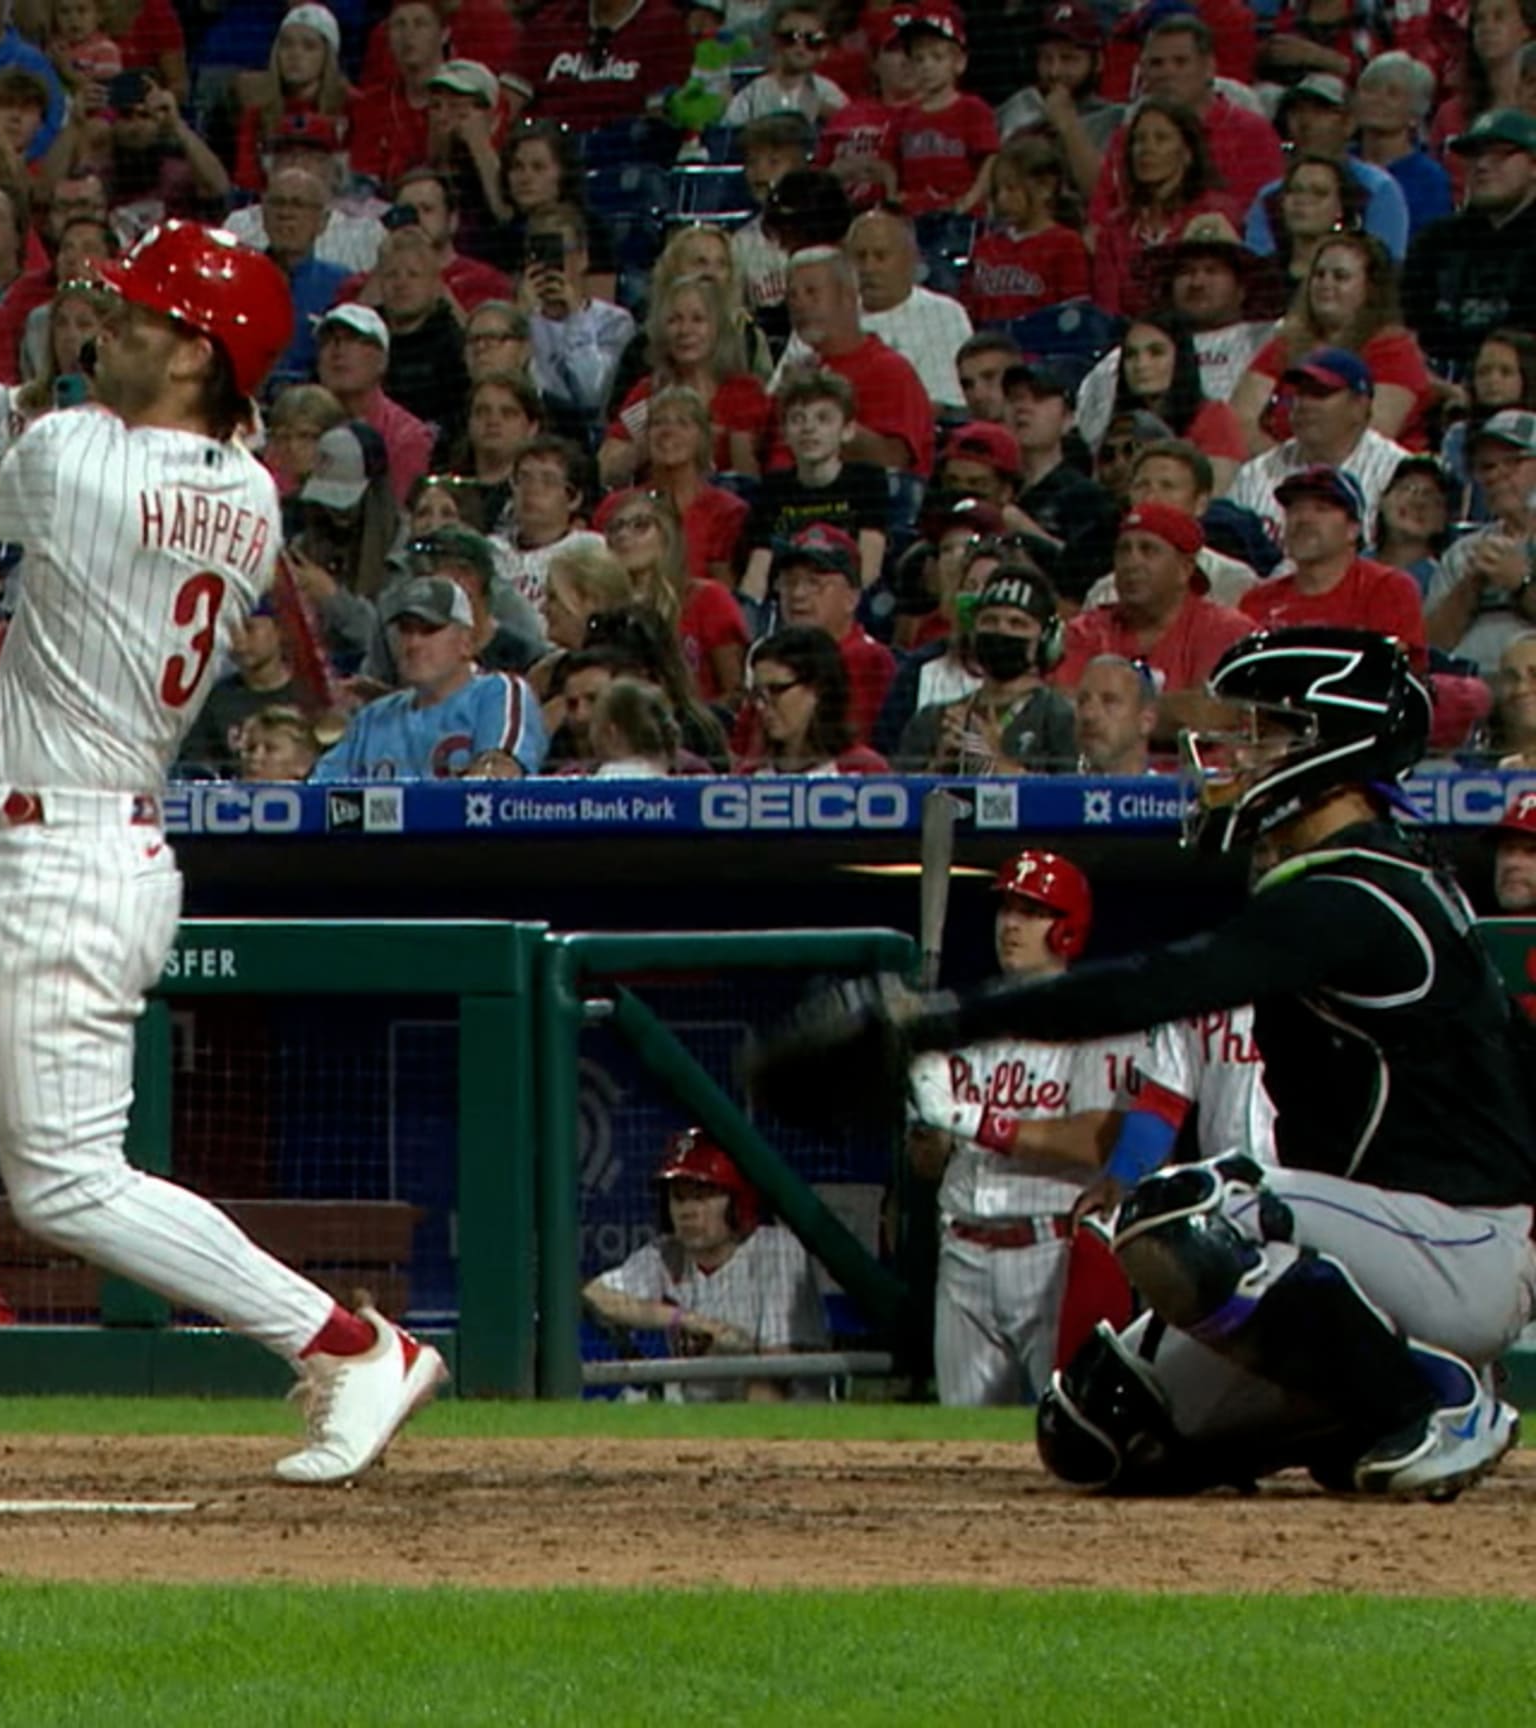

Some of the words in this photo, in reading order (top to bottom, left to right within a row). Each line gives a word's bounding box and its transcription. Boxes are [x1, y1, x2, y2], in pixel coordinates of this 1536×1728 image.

[139, 490, 269, 575] HARPER
[160, 571, 225, 707] 3
[499, 798, 578, 822] Citizens
[580, 799, 629, 821] Bank
[632, 798, 676, 821] Park
[700, 784, 908, 829] GEICO
